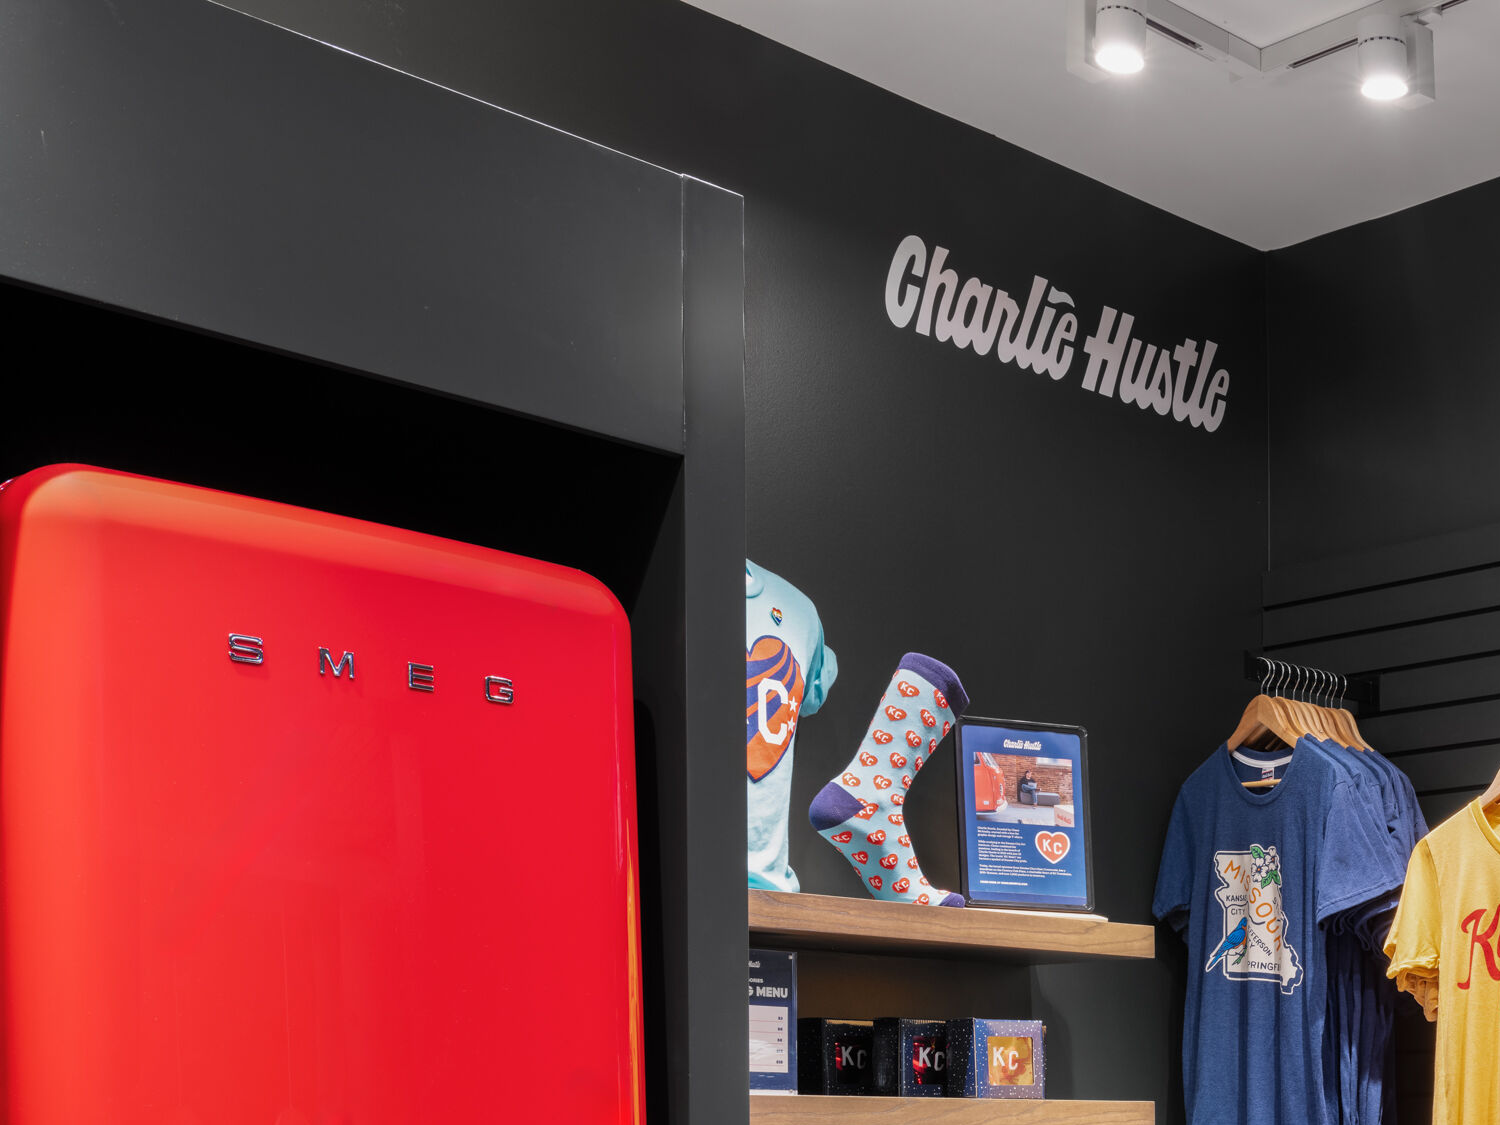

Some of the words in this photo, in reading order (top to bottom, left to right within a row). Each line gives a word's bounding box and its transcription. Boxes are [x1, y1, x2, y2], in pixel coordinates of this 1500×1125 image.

[885, 235, 1077, 381] Charlie
[1081, 305, 1230, 432] Hustle
[228, 633, 514, 704] SMEG
[900, 682, 915, 696] KC
[750, 677, 789, 746] C
[887, 705, 903, 720] KC
[922, 713, 934, 727] KC
[875, 730, 889, 743] KC
[908, 732, 919, 747] KC
[1042, 838, 1063, 855] KC
[1247, 926, 1273, 957] EFFERSON
[756, 986, 789, 998] MENU
[841, 1045, 867, 1070] KC
[918, 1046, 946, 1071] KC
[992, 1046, 1019, 1071] KC
